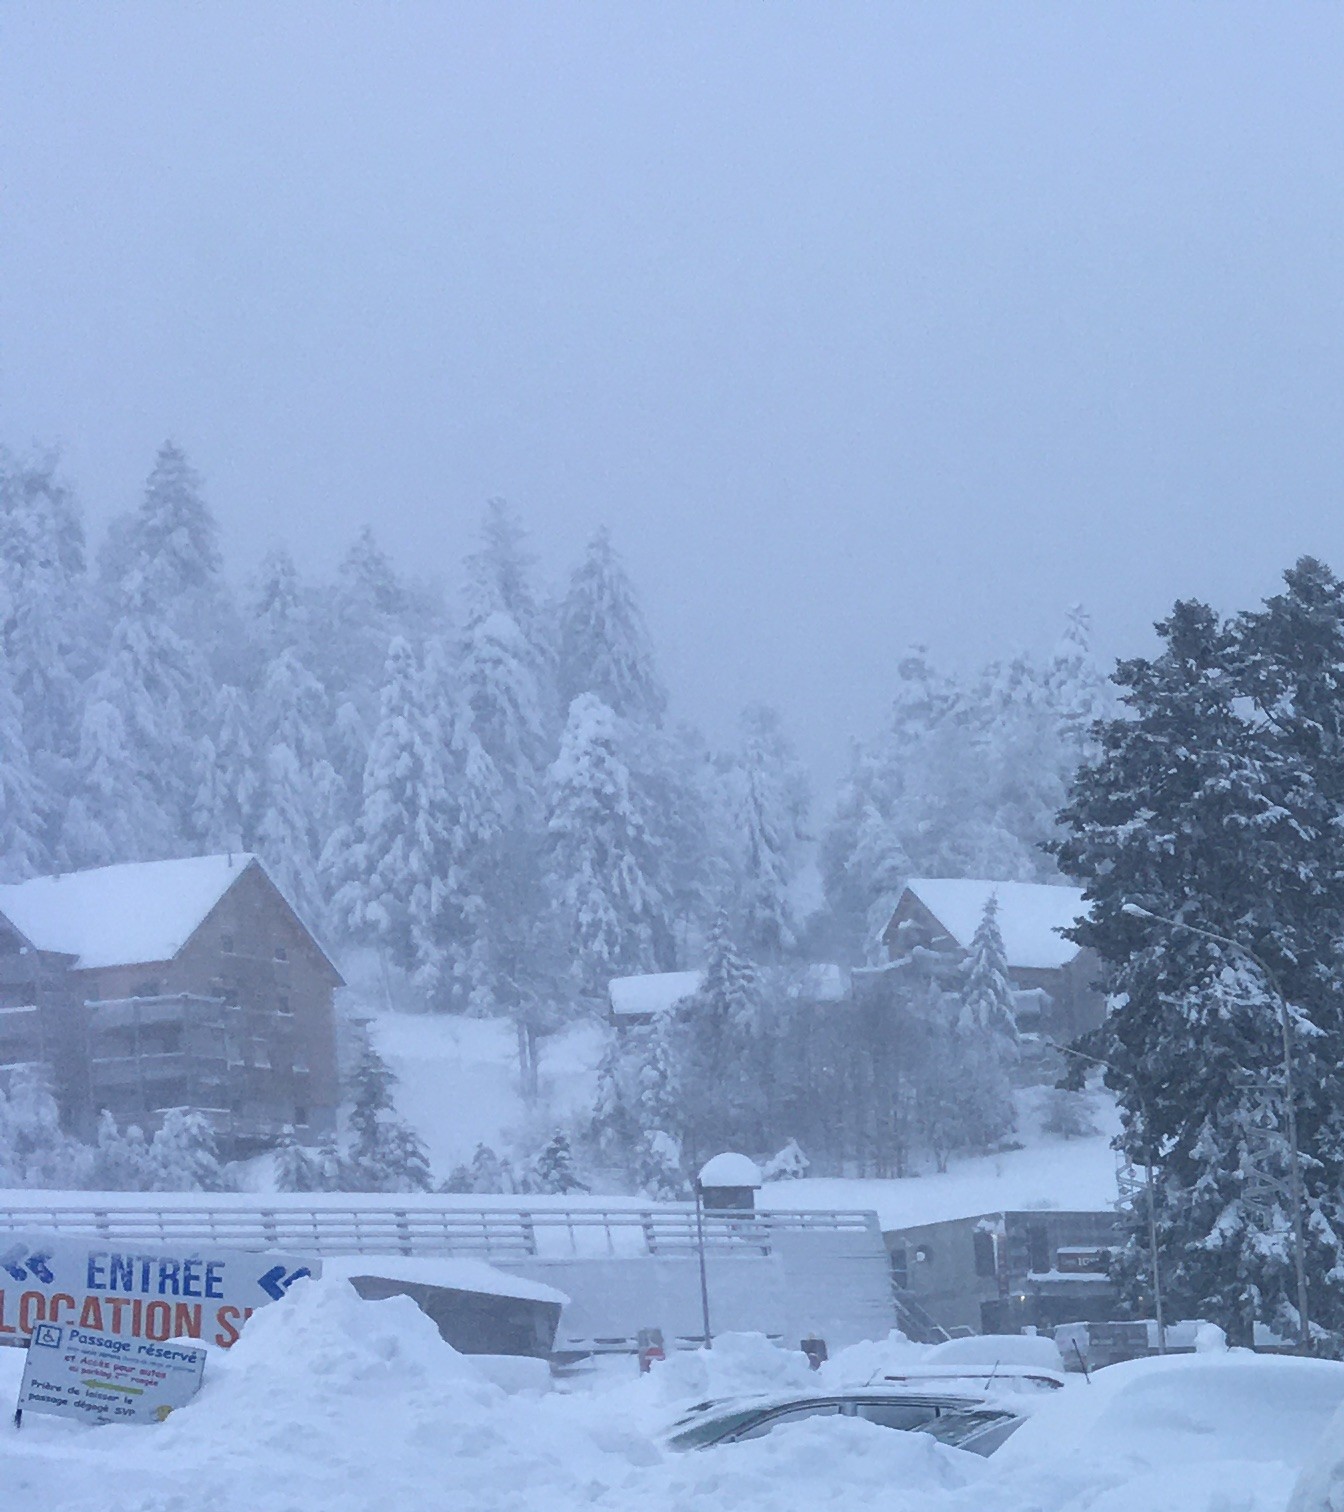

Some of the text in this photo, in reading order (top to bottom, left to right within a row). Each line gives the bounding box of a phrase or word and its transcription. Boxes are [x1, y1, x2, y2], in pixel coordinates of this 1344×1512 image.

[87, 1250, 226, 1299] ENTRÉE
[0, 1290, 253, 1349] LOCATION S
[68, 1329, 197, 1364] Passage réservé
[81, 1366, 112, 1380] parking
[113, 1363, 136, 1375] pour
[28, 1392, 136, 1417] passage dégagé SVP
[31, 1379, 133, 1405] Prière de laisser le
